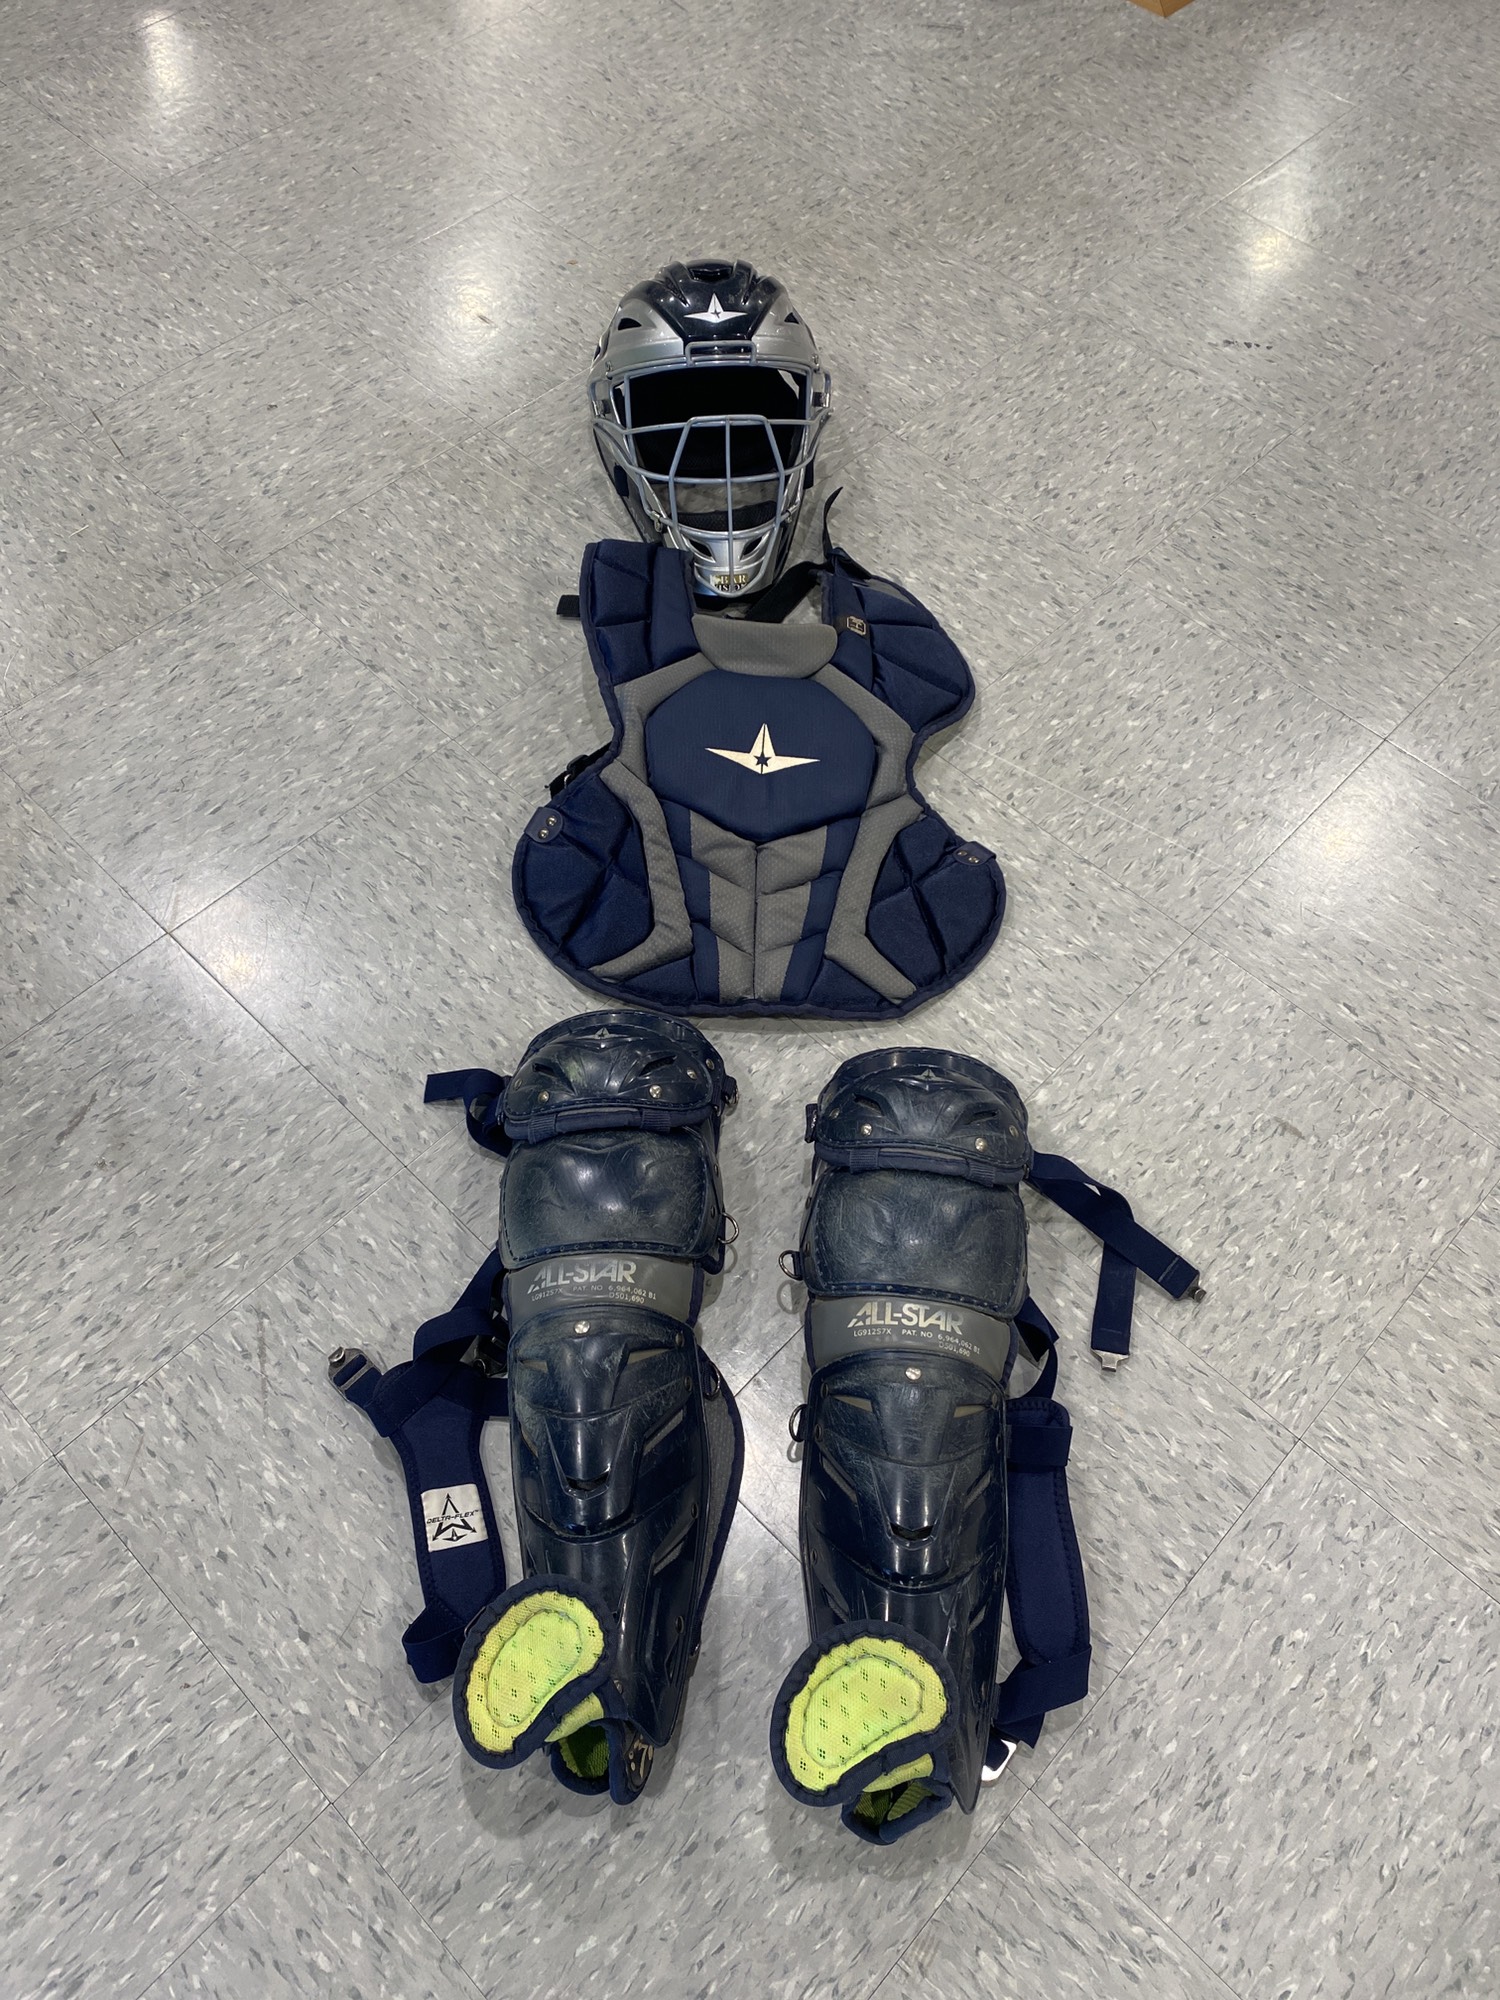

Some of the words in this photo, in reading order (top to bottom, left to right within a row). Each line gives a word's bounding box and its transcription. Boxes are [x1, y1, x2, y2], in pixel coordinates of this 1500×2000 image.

[527, 1260, 637, 1295] ALL-STAR
[847, 1301, 963, 1336] ALL-STAR
[920, 1330, 933, 1339] NO
